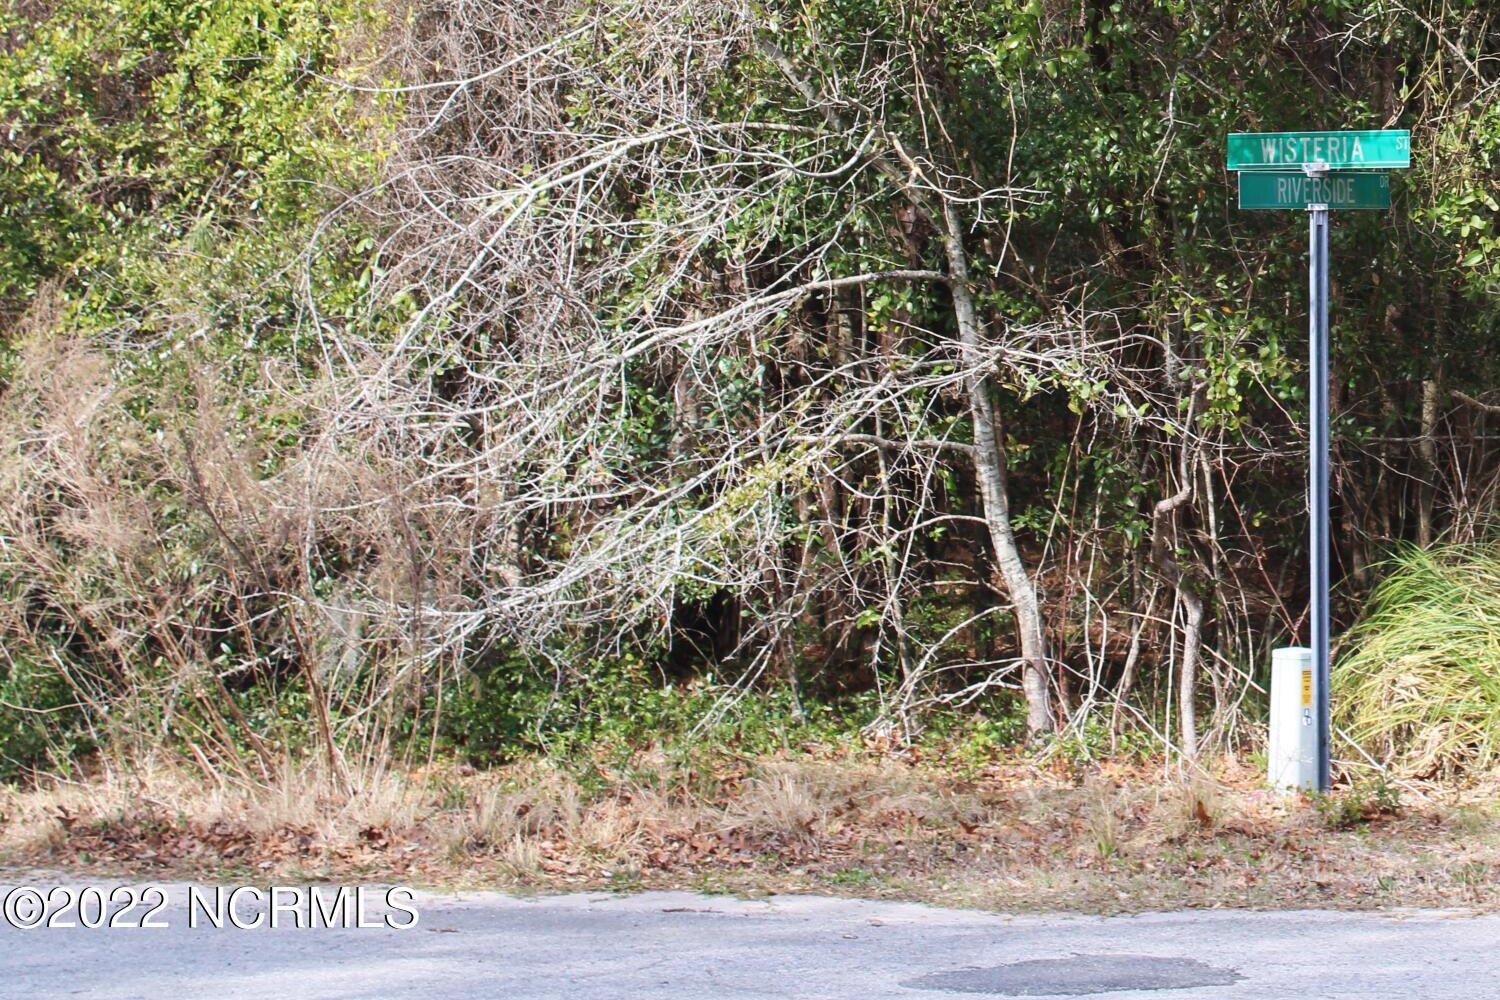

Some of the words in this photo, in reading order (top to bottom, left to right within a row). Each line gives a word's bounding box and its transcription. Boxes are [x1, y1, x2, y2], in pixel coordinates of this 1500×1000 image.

[1260, 136, 1364, 163] WISTERIA
[1396, 137, 1409, 150] ST
[1278, 177, 1356, 204] RIVERSIDE
[1380, 175, 1390, 188] DR
